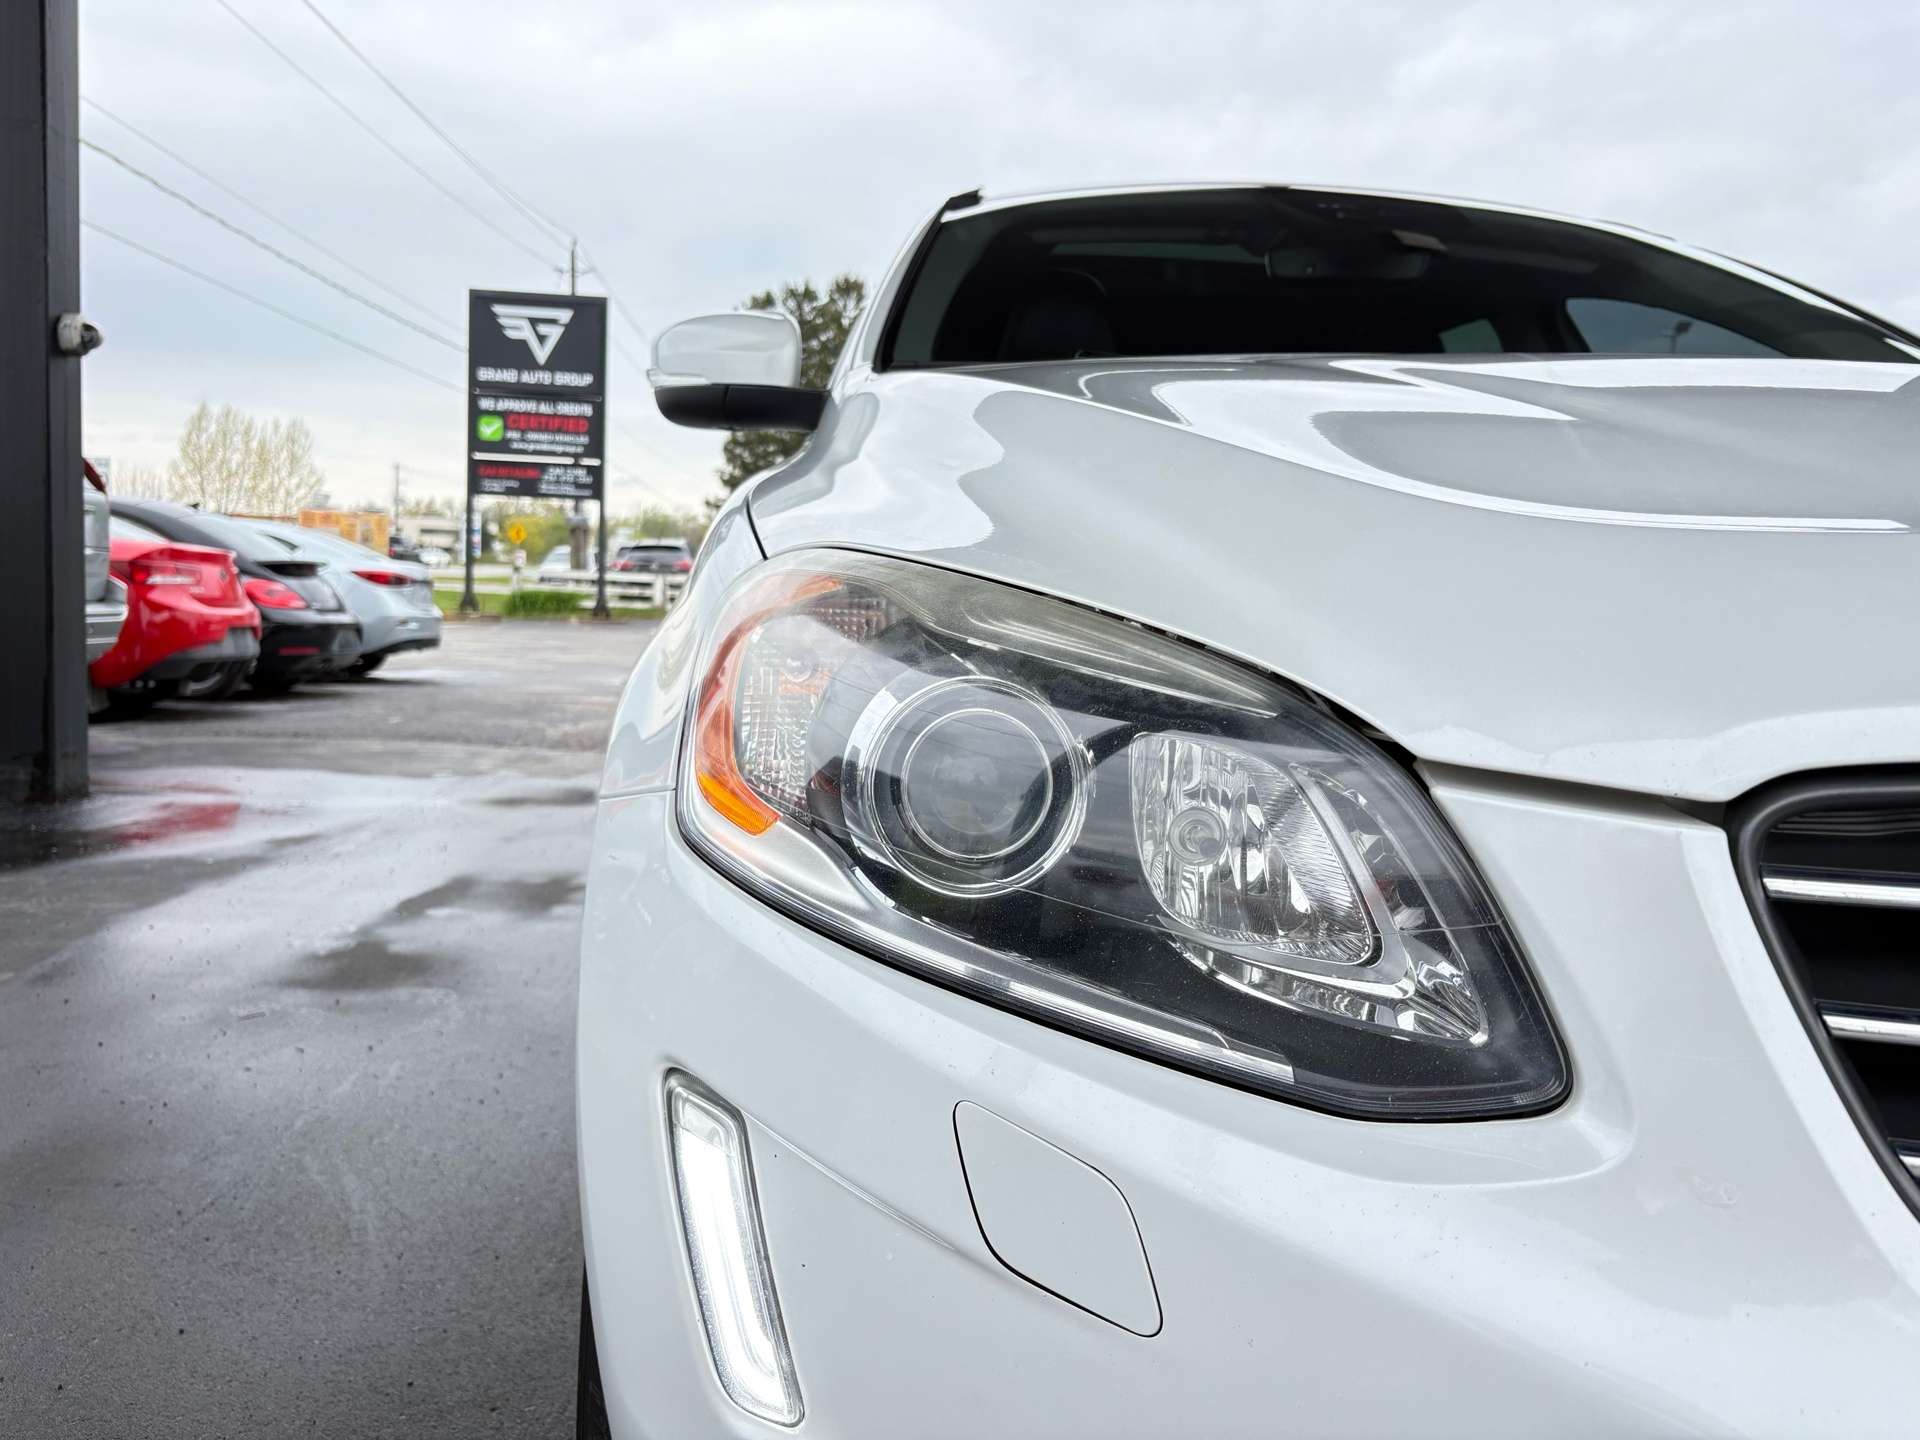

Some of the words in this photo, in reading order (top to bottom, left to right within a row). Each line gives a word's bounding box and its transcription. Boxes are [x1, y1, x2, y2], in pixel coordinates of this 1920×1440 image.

[477, 366, 518, 383] GRAND
[520, 368, 552, 385] AUTO
[553, 370, 593, 387] GROUP
[478, 396, 496, 411] WE
[497, 398, 537, 413] APPROVE
[538, 400, 555, 415] ALL
[507, 413, 589, 433] CERTIFIED
